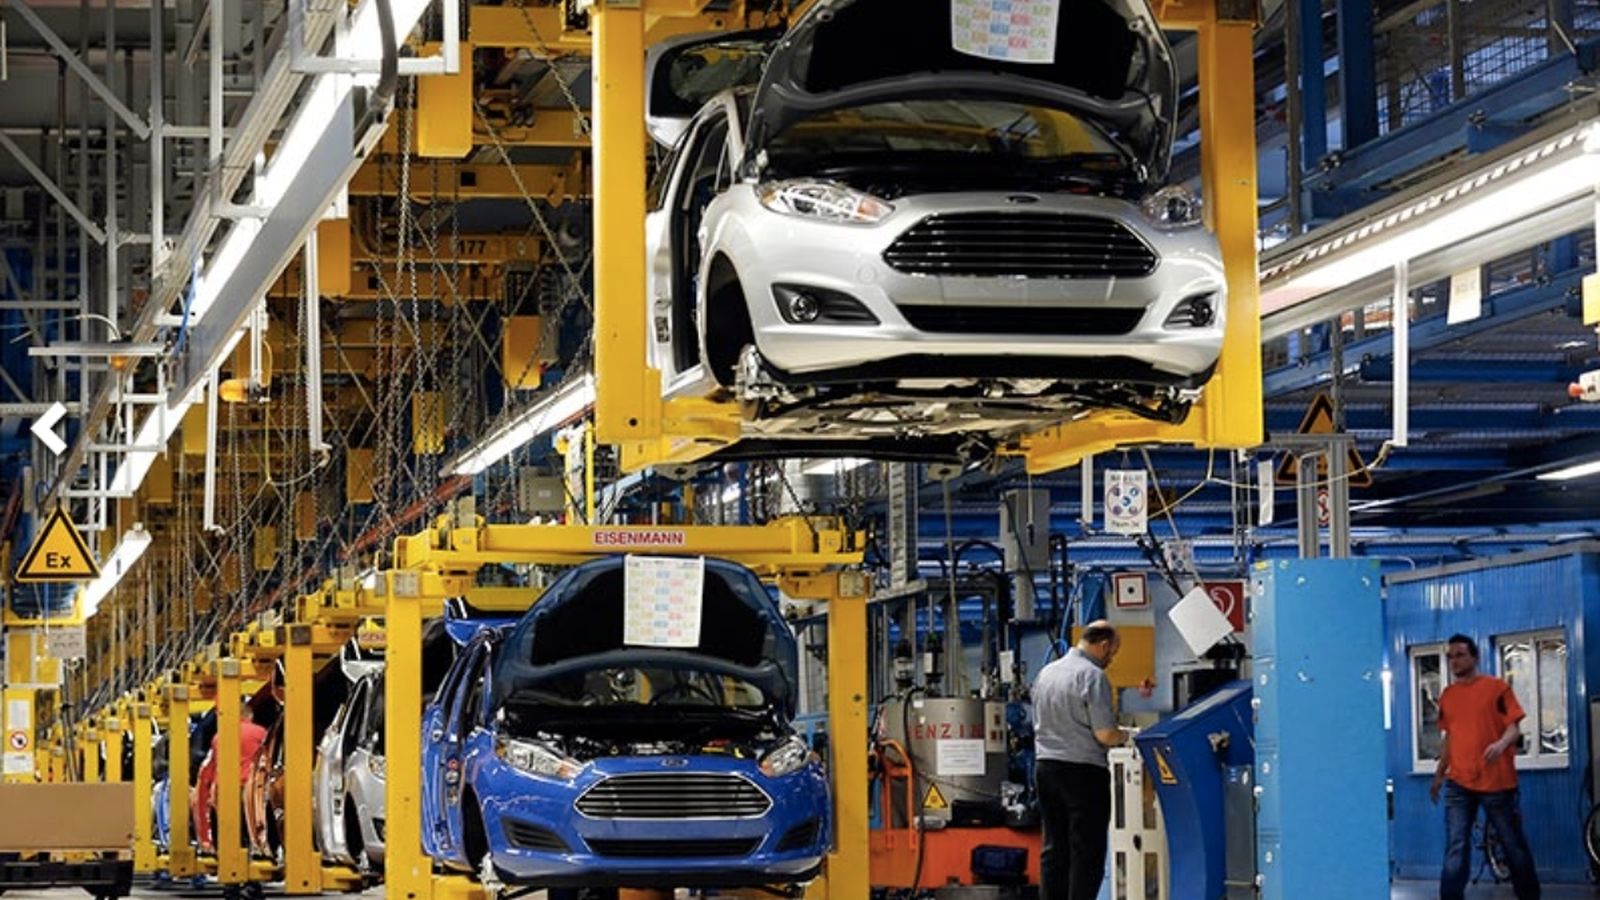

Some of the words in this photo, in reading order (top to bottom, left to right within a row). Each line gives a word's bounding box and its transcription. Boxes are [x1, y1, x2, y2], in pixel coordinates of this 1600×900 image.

[594, 531, 683, 544] EISENMANN
[46, 552, 71, 568] Ex
[908, 723, 984, 739] ENZIN
